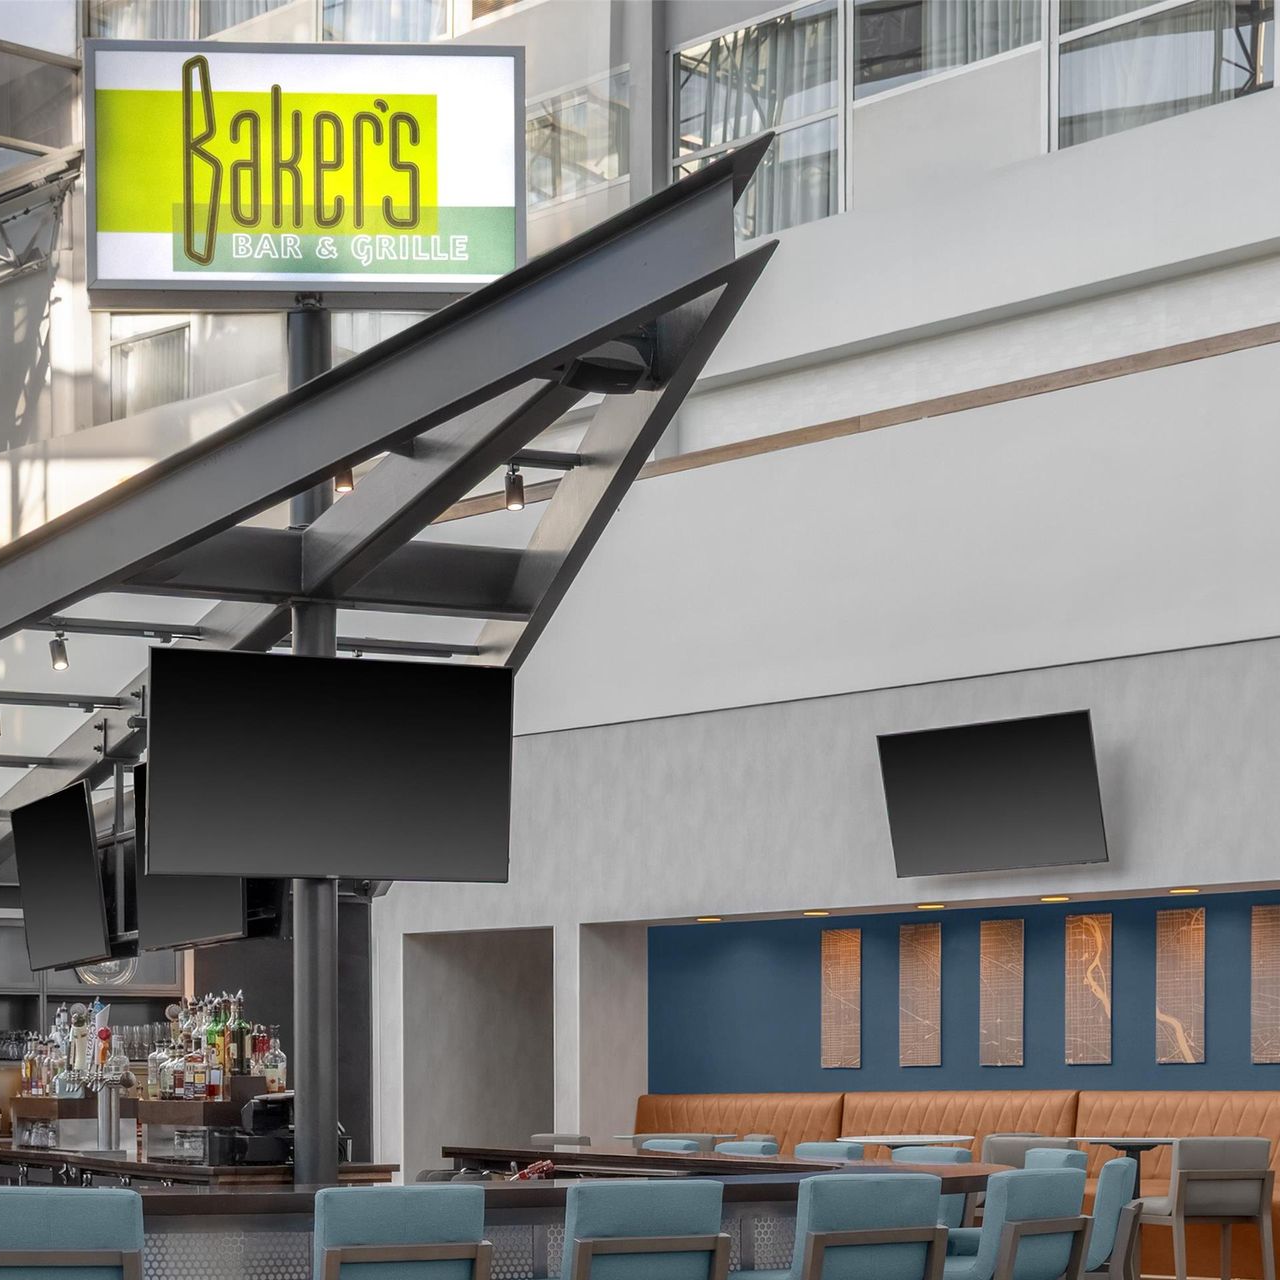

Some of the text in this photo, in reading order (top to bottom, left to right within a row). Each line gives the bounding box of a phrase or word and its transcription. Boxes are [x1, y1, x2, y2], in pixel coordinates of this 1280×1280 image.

[182, 55, 420, 266] Baker's
[232, 234, 469, 266] BAR & GRILLE
